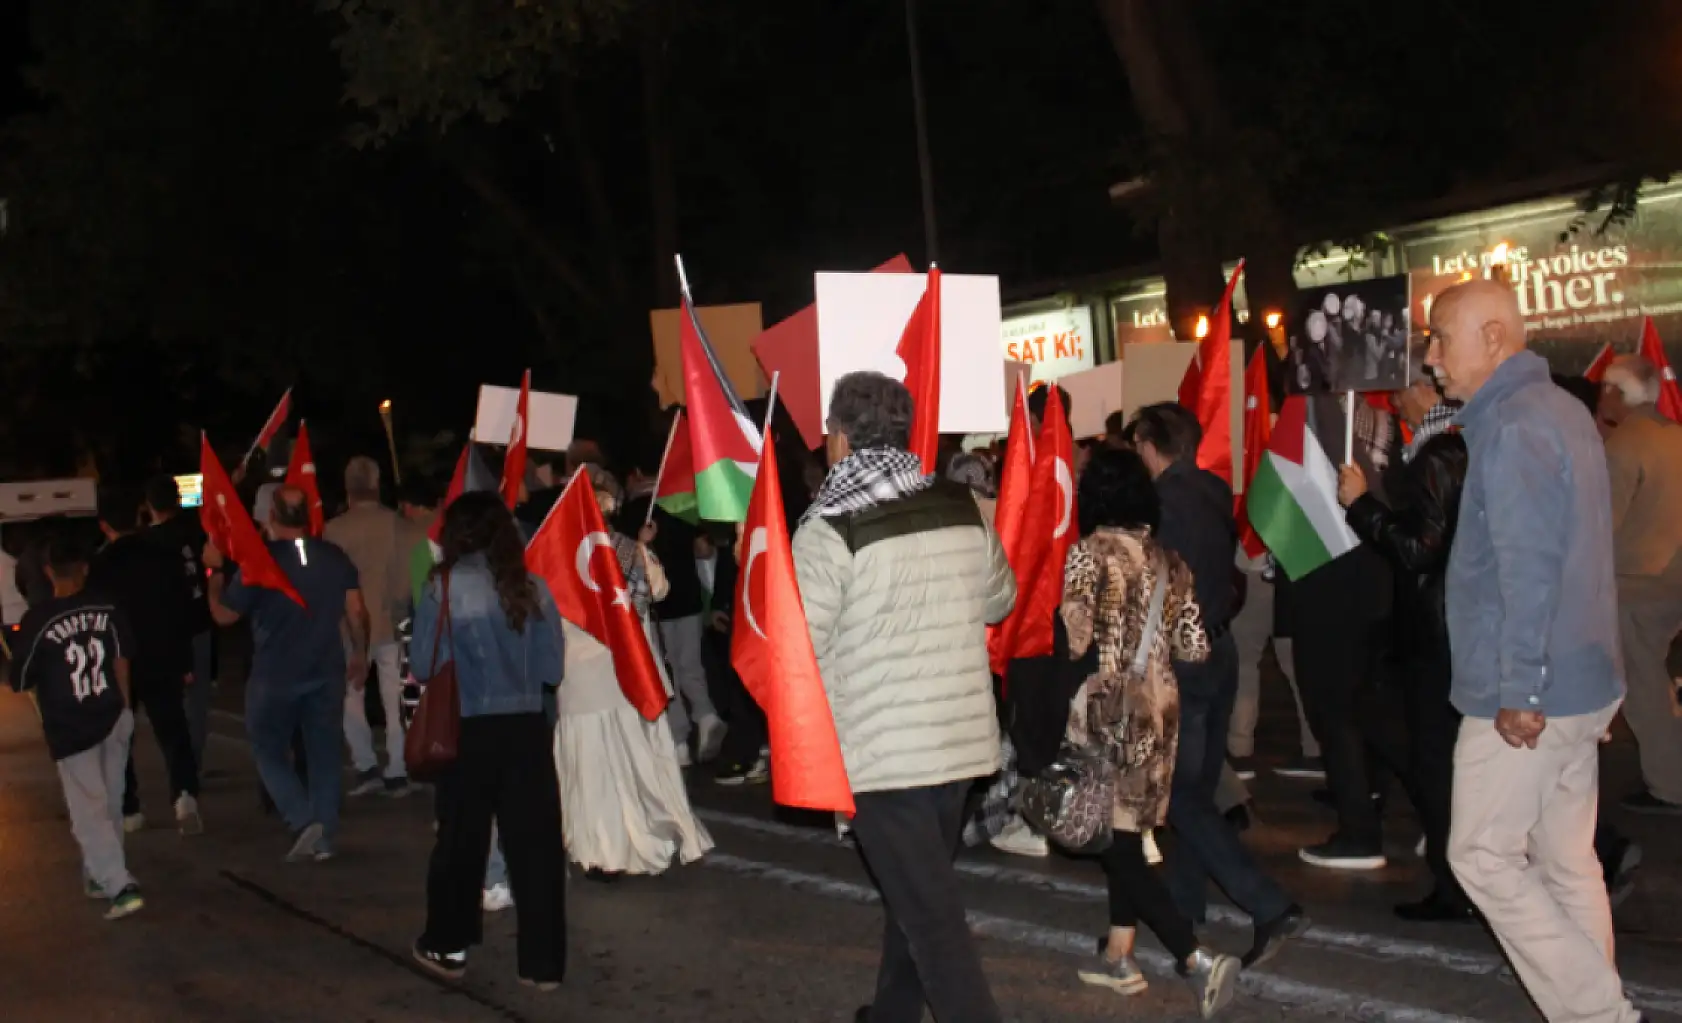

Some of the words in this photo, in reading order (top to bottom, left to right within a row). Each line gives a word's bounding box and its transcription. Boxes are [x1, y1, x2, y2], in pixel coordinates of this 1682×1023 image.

[1432, 250, 1477, 276] Let's
[1537, 243, 1629, 277] voices
[1007, 336, 1046, 364] SAT
[65, 636, 109, 703] 22
